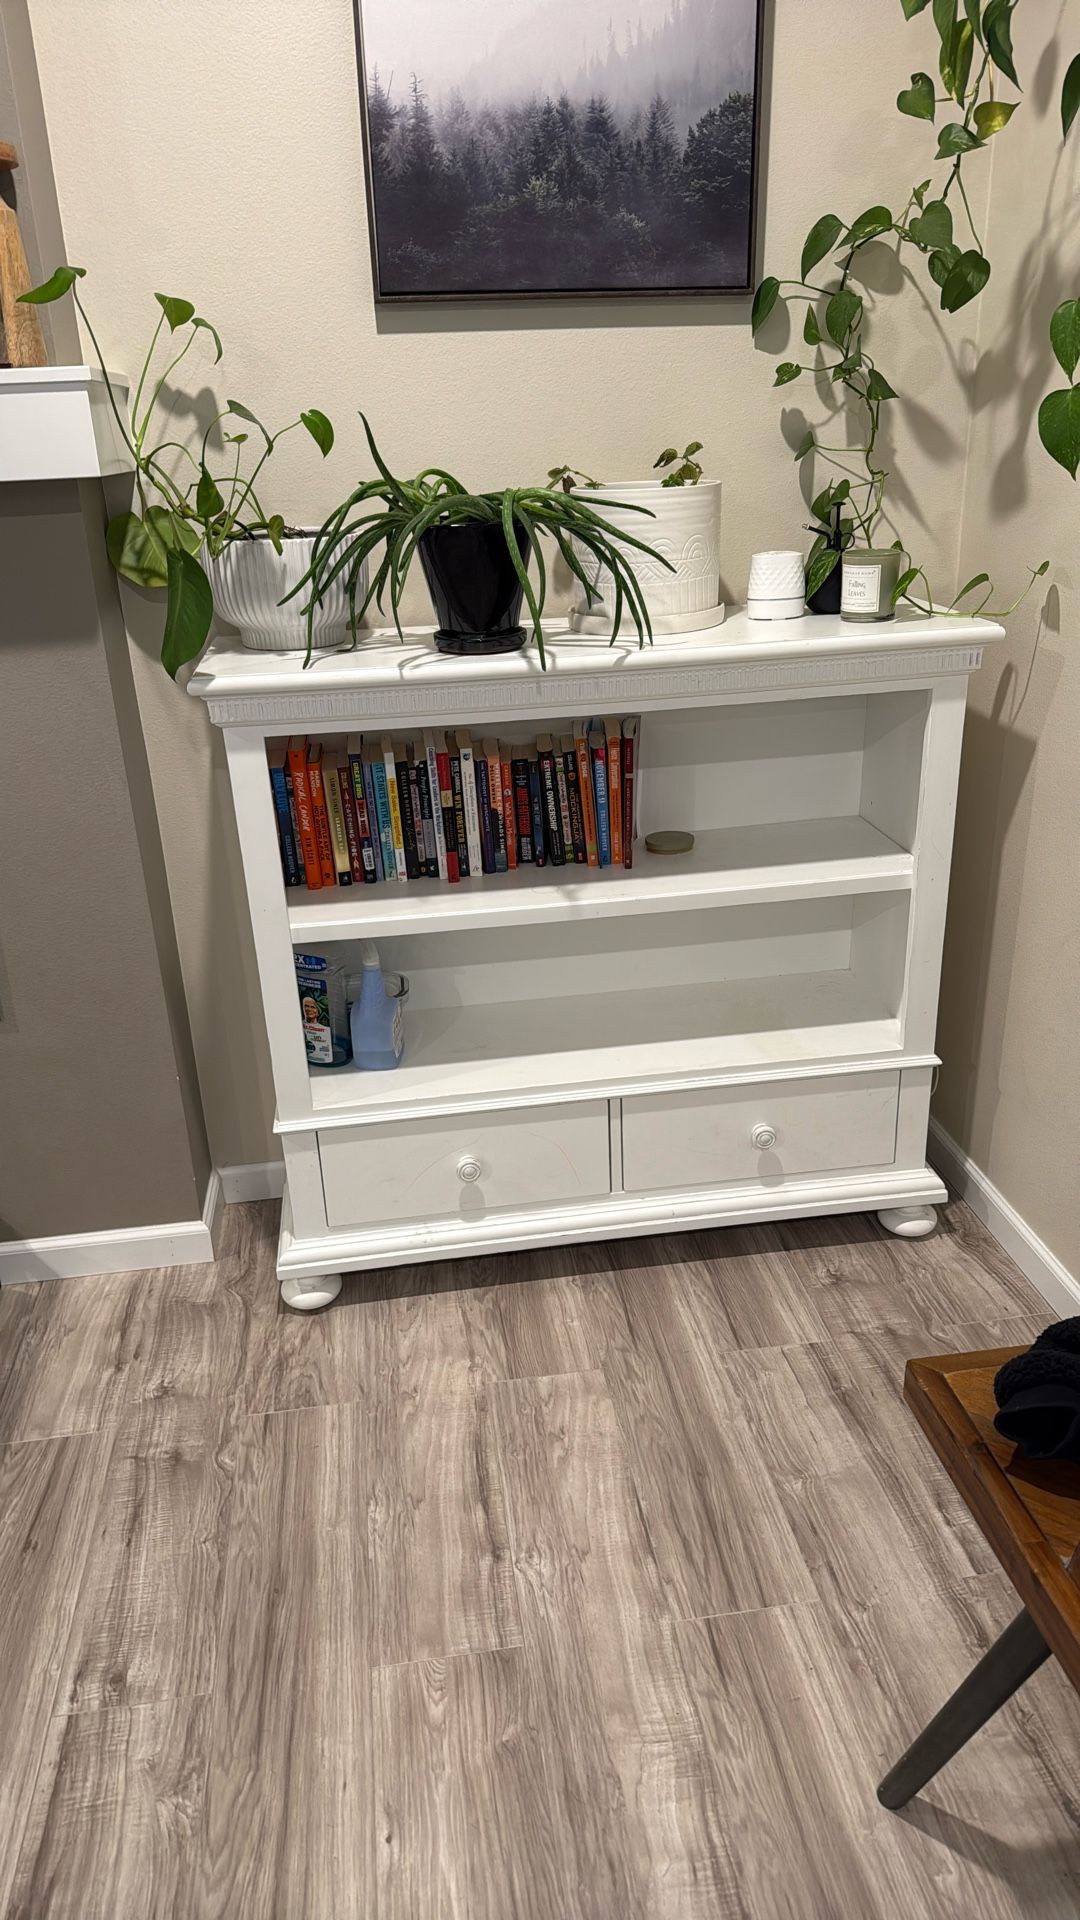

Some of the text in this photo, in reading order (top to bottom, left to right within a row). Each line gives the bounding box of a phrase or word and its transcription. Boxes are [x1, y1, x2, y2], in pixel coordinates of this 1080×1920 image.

[294, 772, 306, 801] RADICAL
[376, 775, 386, 800] STARTS
[401, 771, 409, 797] COLLEEN
[420, 776, 428, 794] People
[543, 760, 553, 789] EXTREME
[595, 760, 605, 795] NOVEMBER
[422, 795, 430, 818] Principle
[432, 786, 440, 802] Leaders
[454, 795, 462, 808] WIN
[517, 787, 529, 805] JAMES
[299, 805, 310, 831] CANDOR
[345, 804, 354, 838] CATCHING
[379, 802, 389, 818] WITH
[519, 806, 531, 835] PATTERSON
[546, 791, 557, 831] OWNERSHIP
[570, 788, 580, 845] MOCKINGJAY
[382, 820, 390, 829] US
[435, 815, 443, 835] Workplace
[455, 811, 465, 843] FOREVER
